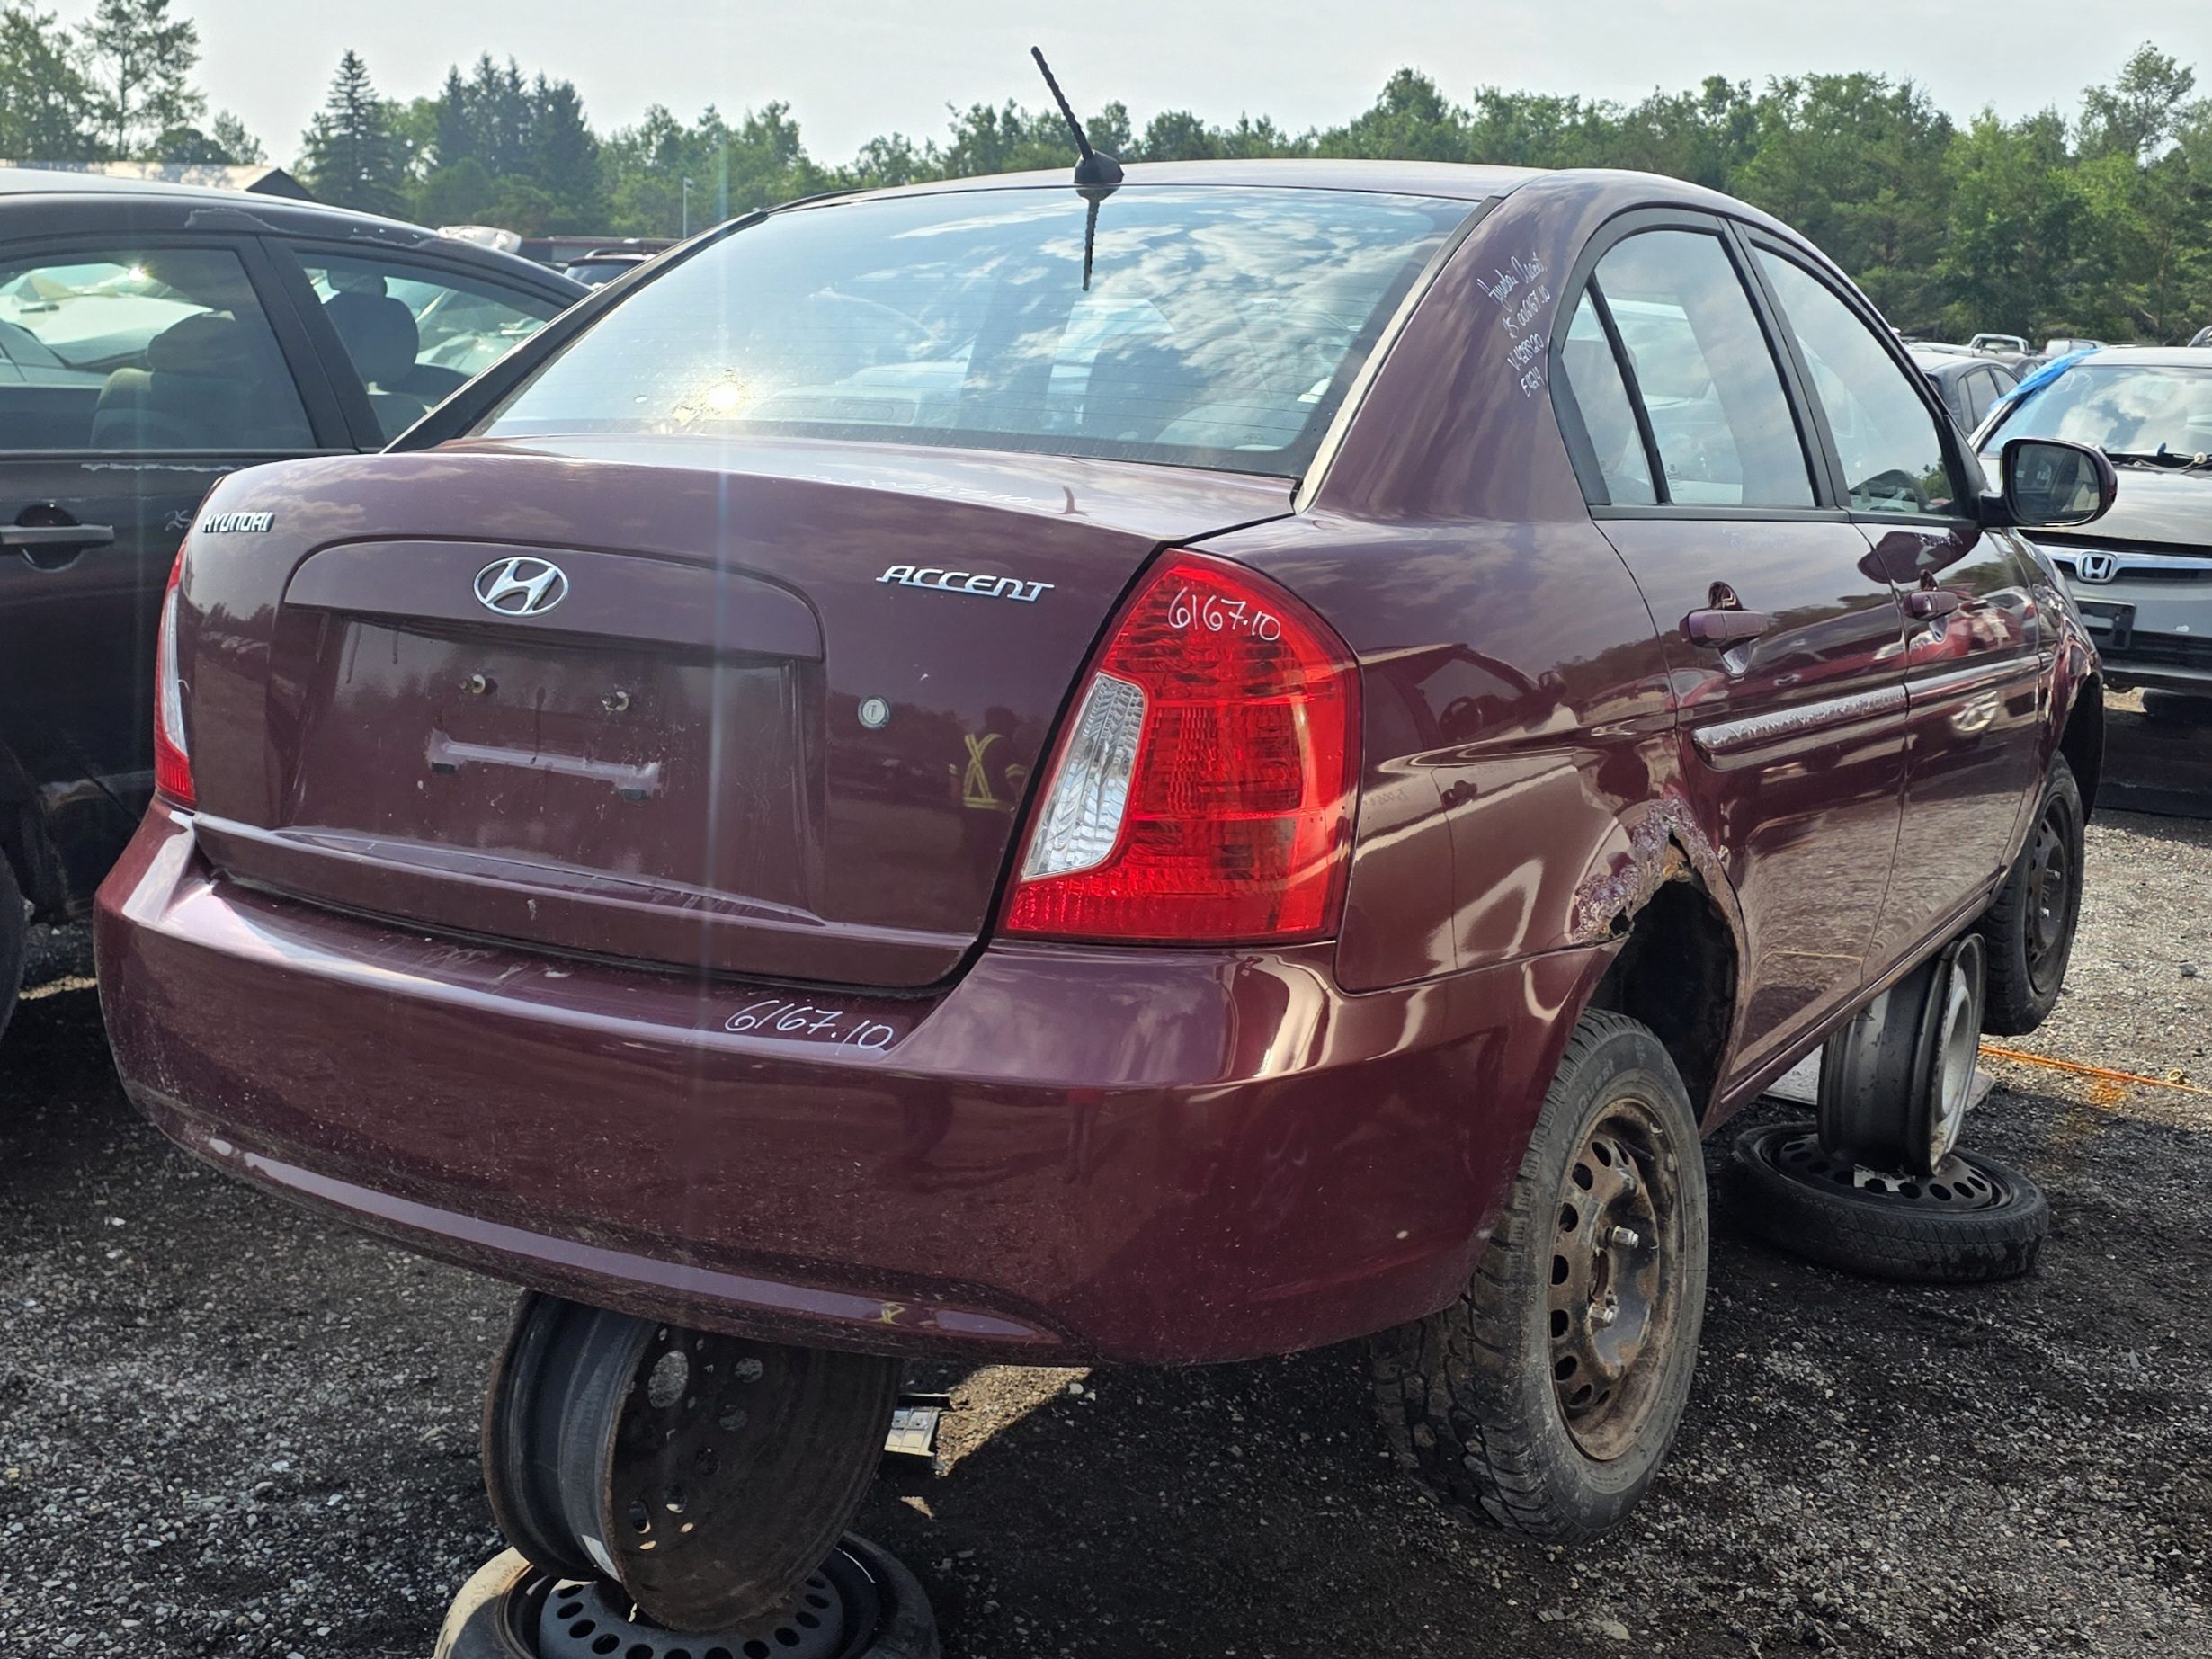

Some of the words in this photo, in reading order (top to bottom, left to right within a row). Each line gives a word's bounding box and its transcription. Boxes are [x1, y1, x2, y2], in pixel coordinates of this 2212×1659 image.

[1517, 285, 1551, 326] 006167.10
[202, 511, 274, 533] HYUNDAI
[876, 565, 1056, 602] ACCENT
[1167, 586, 1281, 641] 6167.10
[724, 999, 895, 1056] 6167.10
